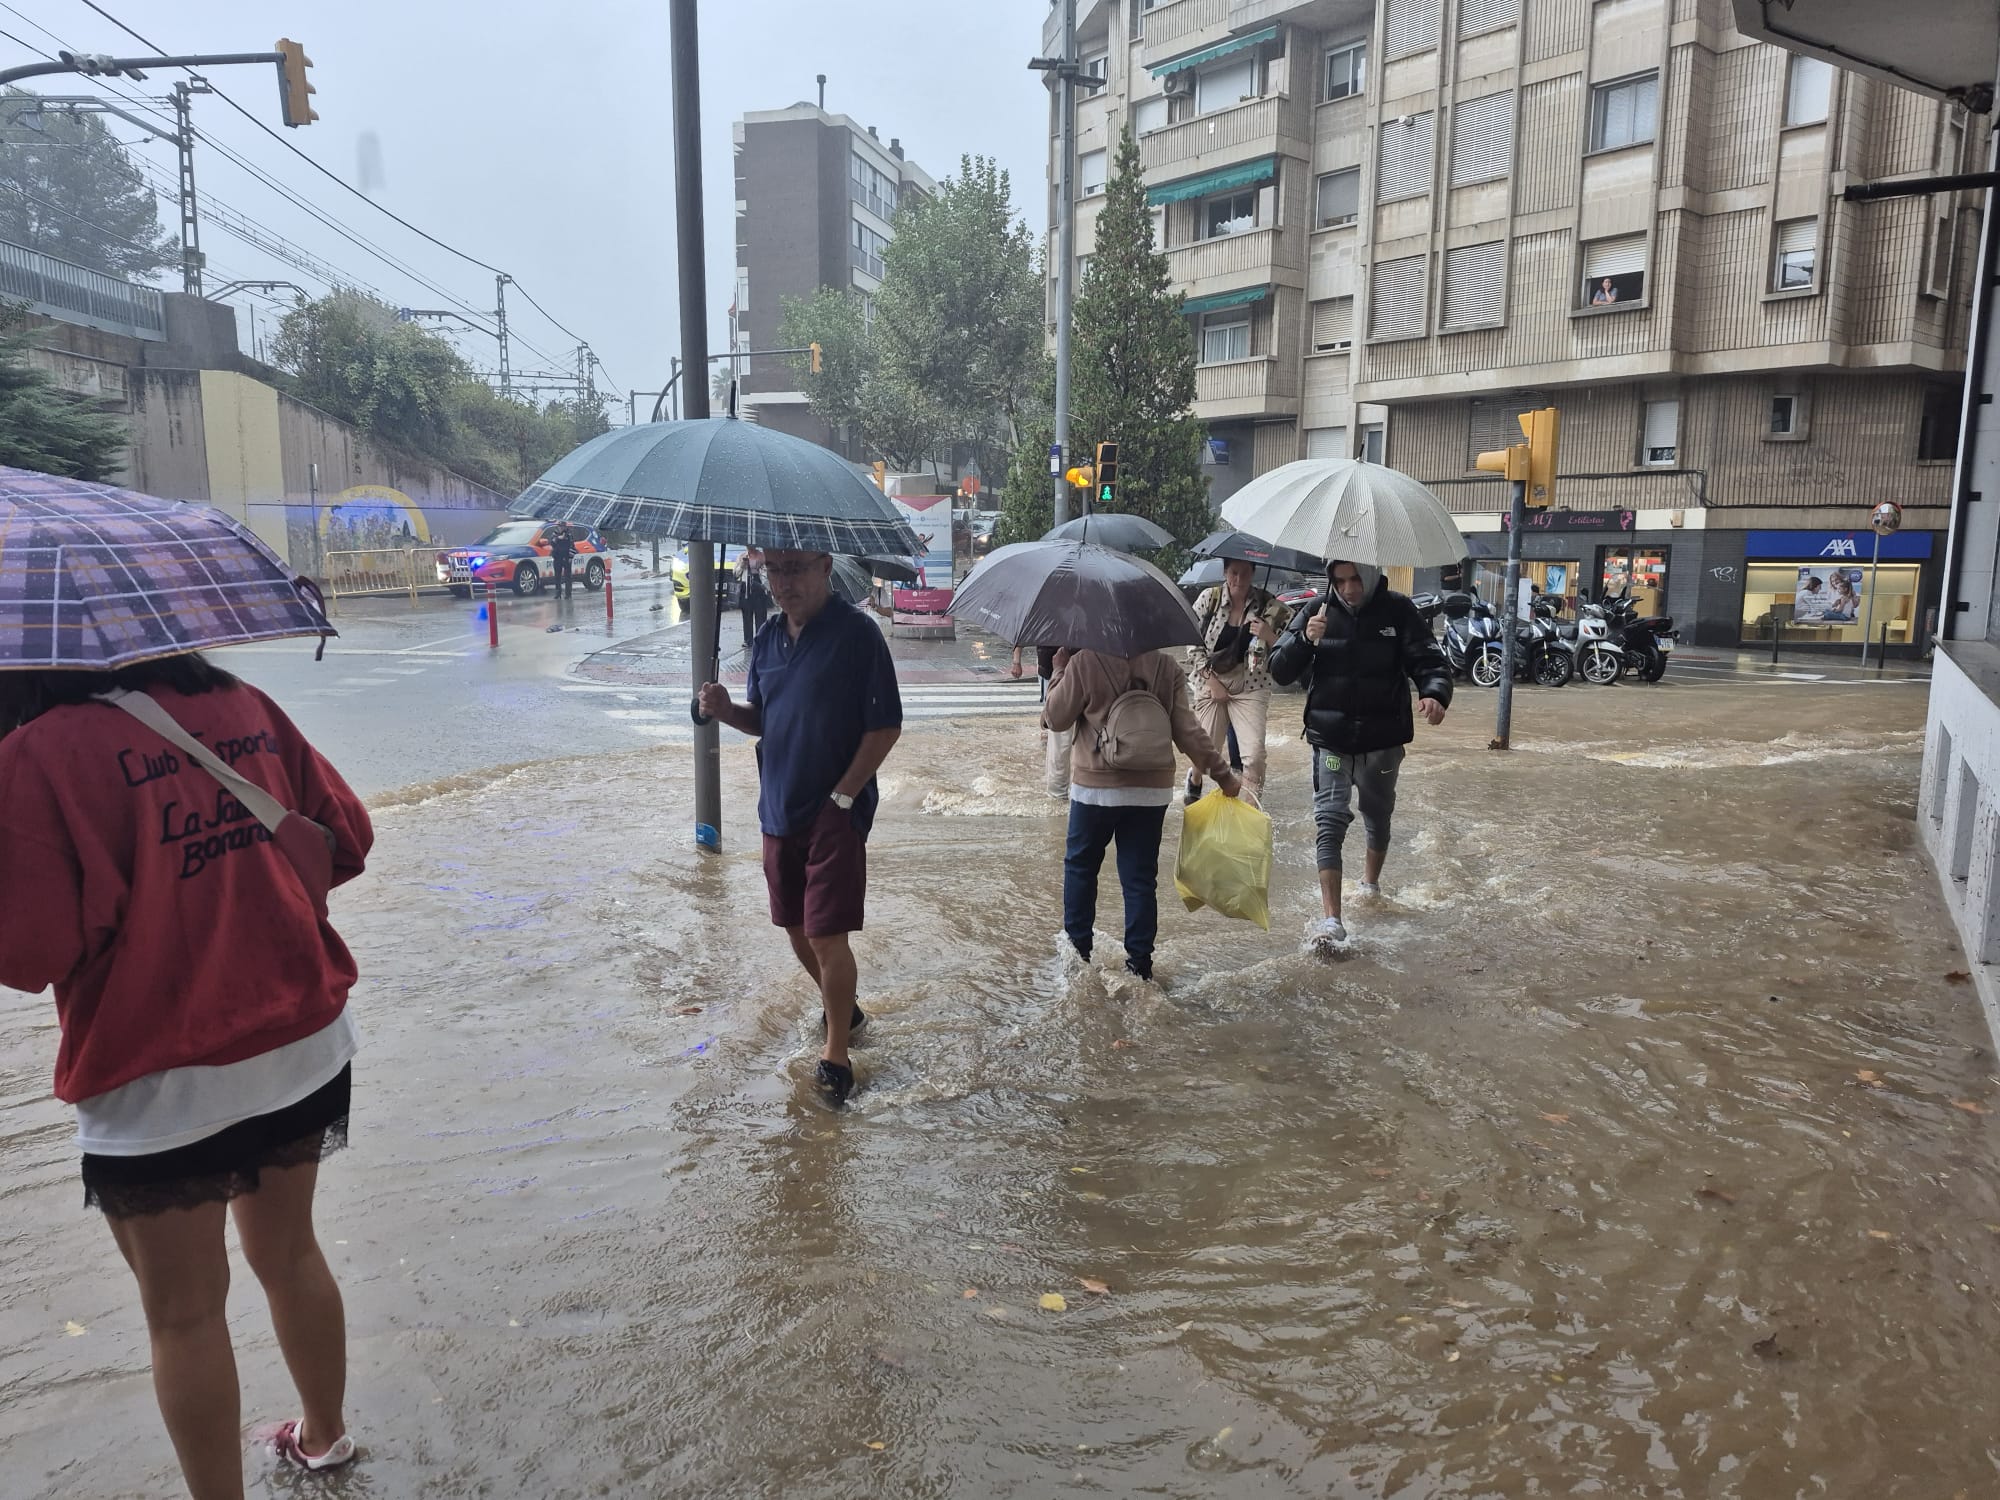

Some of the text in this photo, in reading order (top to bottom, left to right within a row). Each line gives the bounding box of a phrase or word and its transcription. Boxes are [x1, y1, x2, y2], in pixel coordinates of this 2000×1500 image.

[1568, 515, 1605, 525] Estilistas
[1818, 538, 1857, 557] AXA
[117, 748, 180, 787] Club
[160, 801, 202, 845] La
